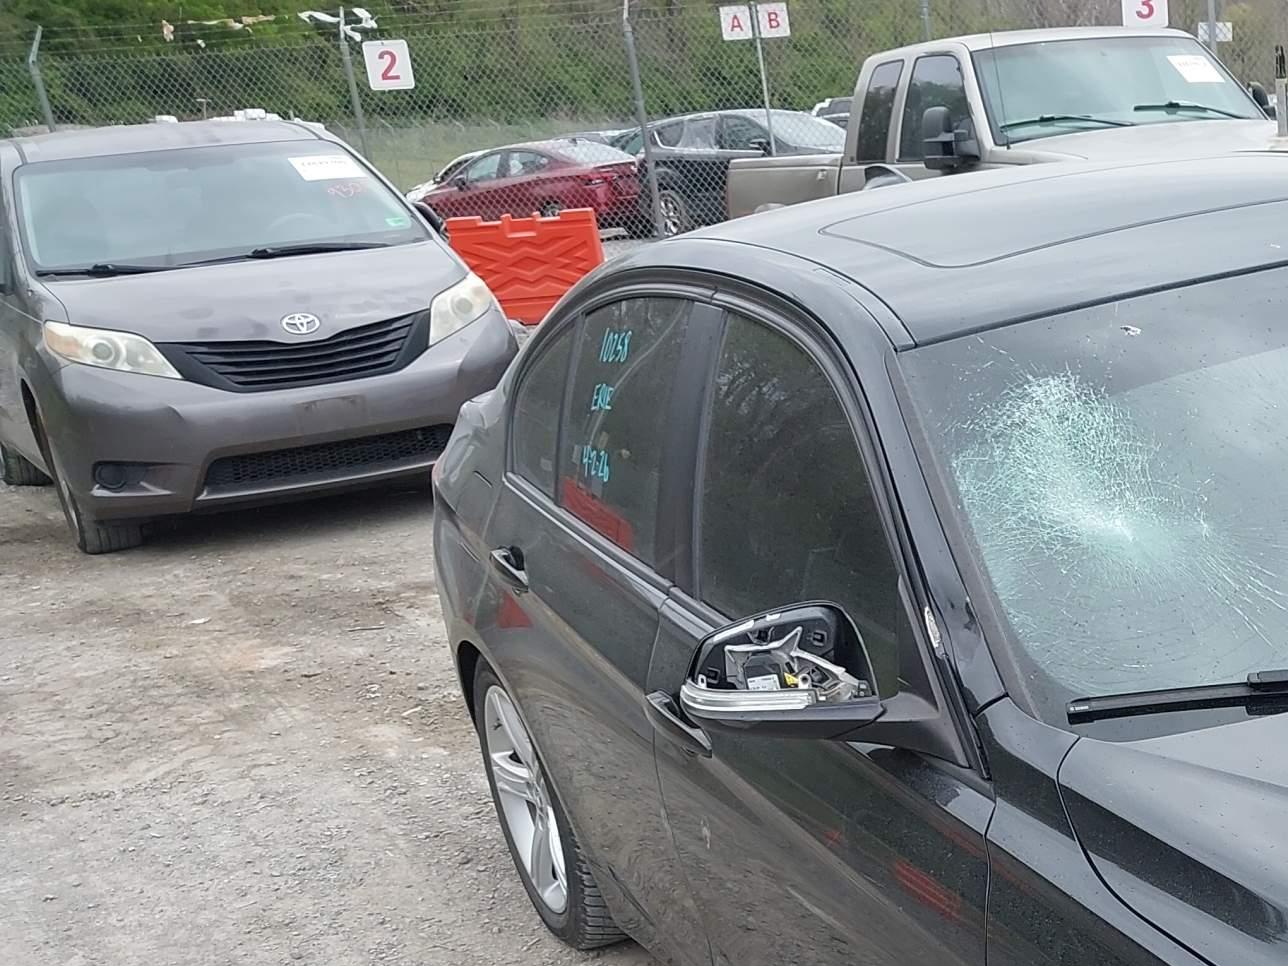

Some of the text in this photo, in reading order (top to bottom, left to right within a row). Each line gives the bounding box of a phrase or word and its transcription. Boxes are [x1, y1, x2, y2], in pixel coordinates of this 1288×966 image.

[1135, 0, 1154, 19] 3
[730, 14, 744, 32] A
[767, 11, 780, 29] B
[378, 50, 401, 80] 2
[600, 328, 632, 363] 10258
